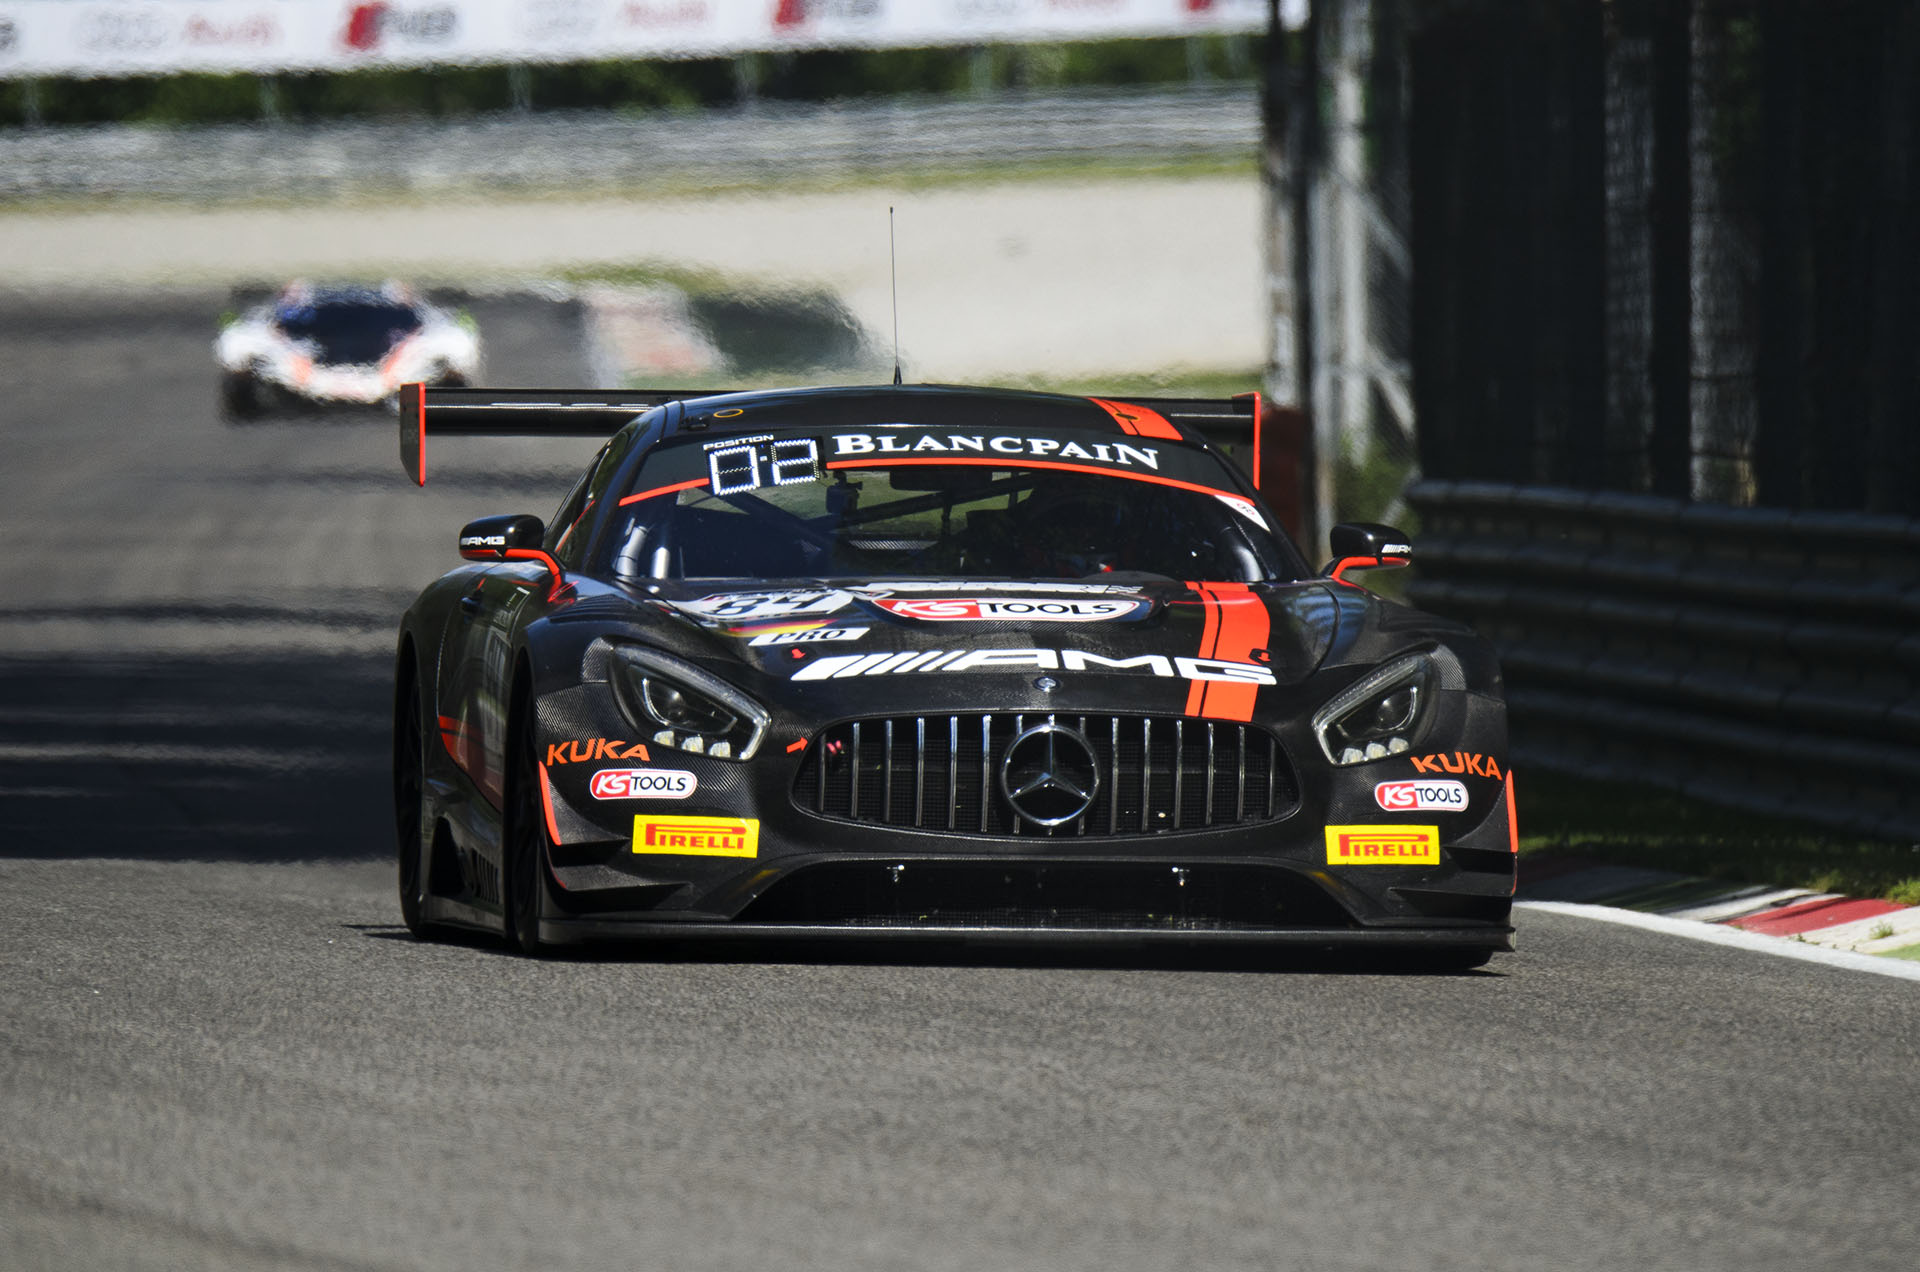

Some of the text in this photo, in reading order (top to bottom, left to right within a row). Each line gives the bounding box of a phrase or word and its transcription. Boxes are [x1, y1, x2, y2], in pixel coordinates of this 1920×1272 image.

[703, 434, 774, 450] POSITION
[832, 434, 1158, 470] BLANCPAIN
[772, 629, 846, 643] PRO
[942, 649, 1276, 686] AMG
[546, 738, 650, 766] KUKA
[1410, 751, 1503, 781] KUKA
[645, 823, 747, 850] PIRELLI
[1339, 834, 1429, 857] PIRELLI
